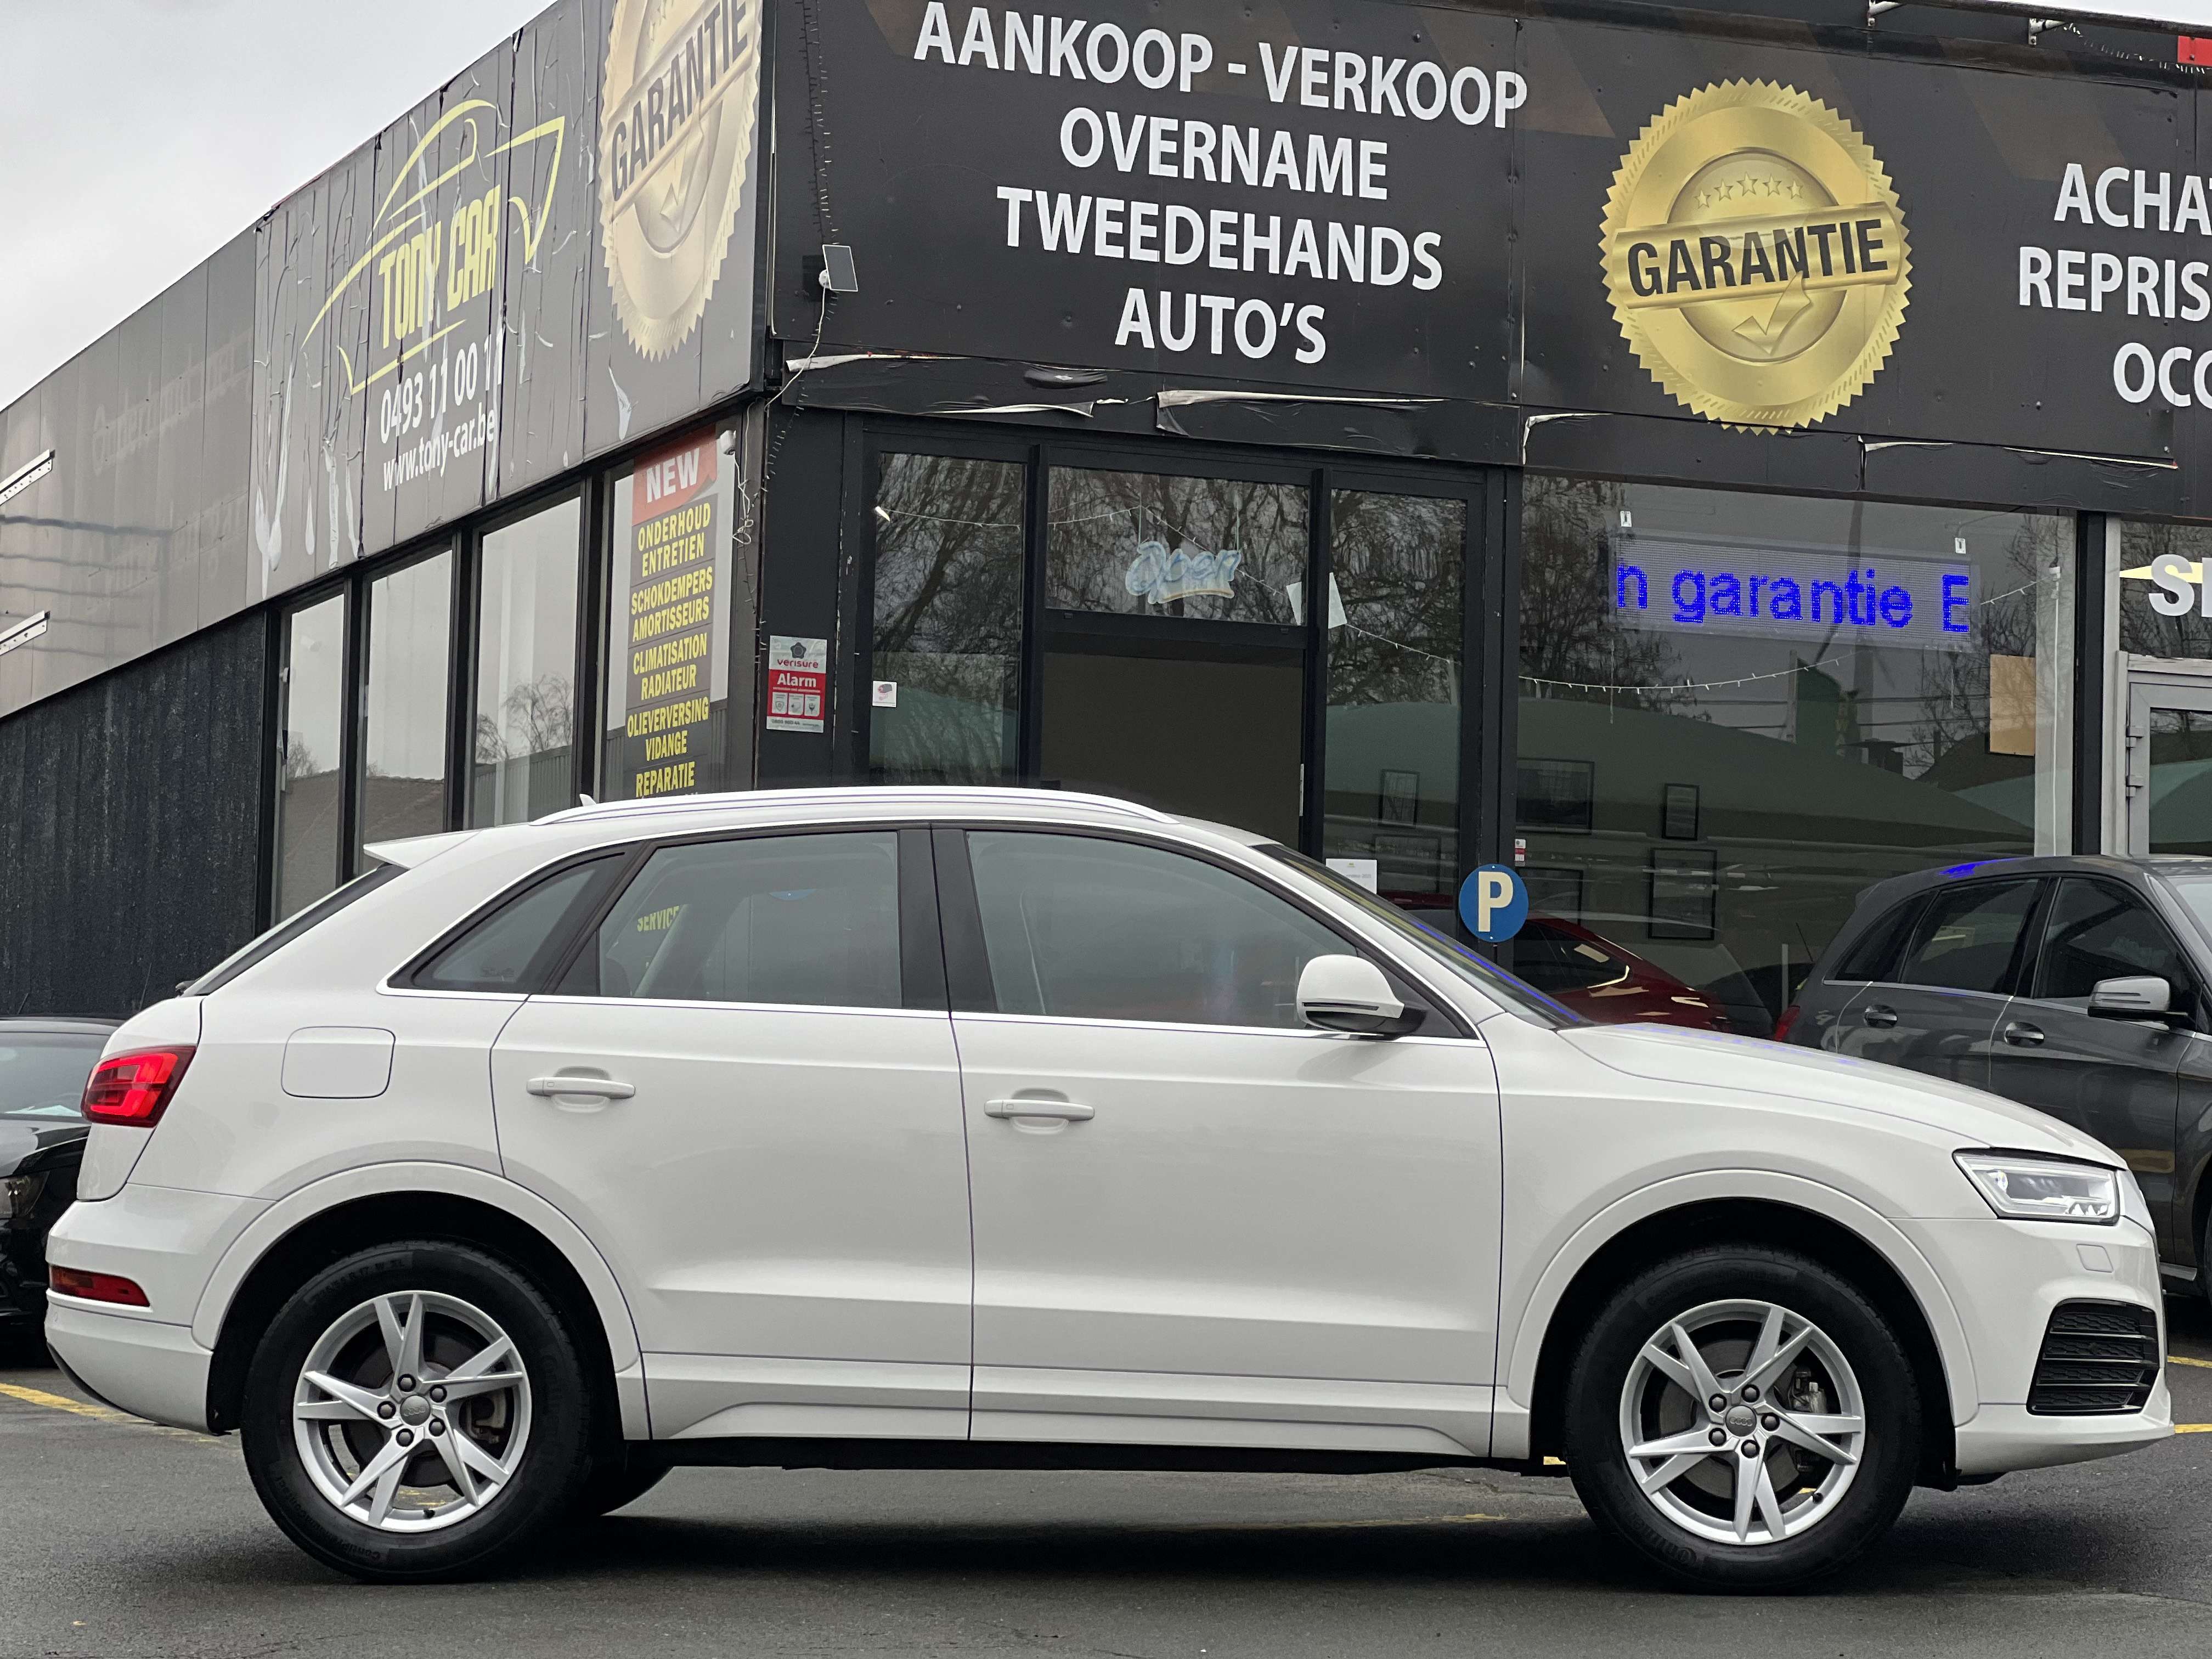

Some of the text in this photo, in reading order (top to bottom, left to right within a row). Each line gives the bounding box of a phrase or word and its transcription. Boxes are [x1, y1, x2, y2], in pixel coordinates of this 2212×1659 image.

[913, 1, 1213, 93] AANKOOP
[1259, 42, 1528, 129] VERKOOP
[612, 0, 747, 201] GARANTIE
[1060, 107, 1389, 200] OVERNAME
[2053, 163, 2212, 236] ACHA
[379, 184, 500, 349] TONY CAR
[996, 186, 1443, 290] TWEEDEHANDS
[1627, 218, 1888, 297] GARANTIE
[1114, 287, 1326, 364] AUTO’S
[381, 328, 504, 444] 0493 11 00 11
[383, 402, 495, 491] www.tony-car.be
[646, 448, 700, 503] NEW
[637, 503, 710, 551] ONDERHOUD
[642, 532, 704, 577] ENTRETIEN
[631, 565, 713, 615] SCHOKDEMPERS
[633, 596, 709, 642] AMORTISSEURS
[1672, 568, 1913, 628] garantie
[1942, 574, 1970, 633] E
[633, 633, 707, 675] CLIMATISATION
[641, 664, 697, 701] RADIATEUR
[777, 658, 819, 668] verisure
[777, 673, 817, 688] Alarm
[627, 697, 709, 738] OLIEVERVERSING
[645, 730, 688, 761] VIDANGE
[636, 761, 695, 798] REPARATIE
[1478, 871, 1514, 932] P
